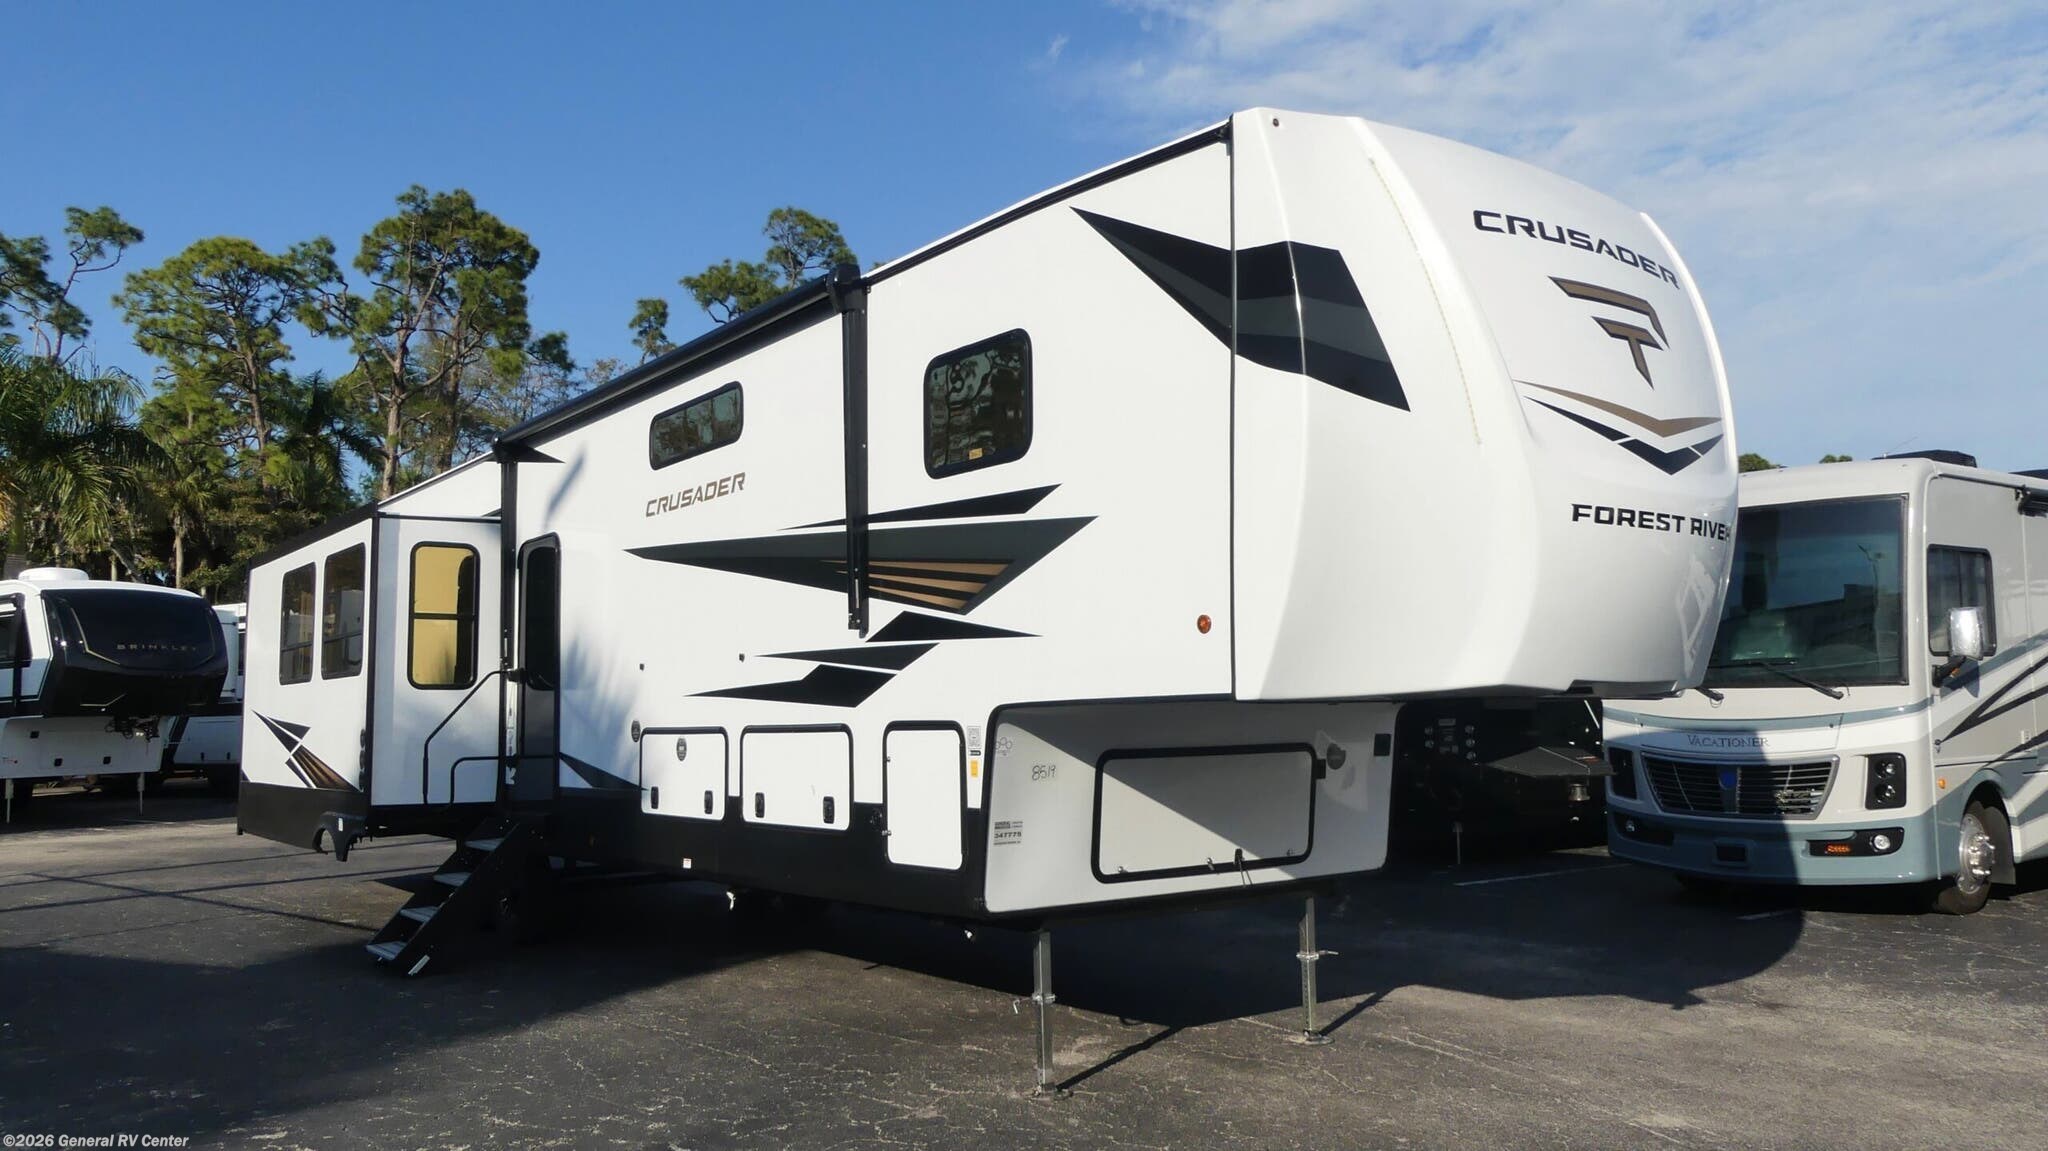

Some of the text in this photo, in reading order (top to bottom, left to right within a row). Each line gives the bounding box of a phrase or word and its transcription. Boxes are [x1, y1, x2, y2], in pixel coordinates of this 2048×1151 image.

[1473, 209, 1680, 290] CRUSADER
[645, 471, 746, 518] CRUSADER
[1571, 503, 1686, 533] FOREST
[116, 643, 197, 652] BRINKLEY
[1687, 734, 1770, 748] VACATIONER
